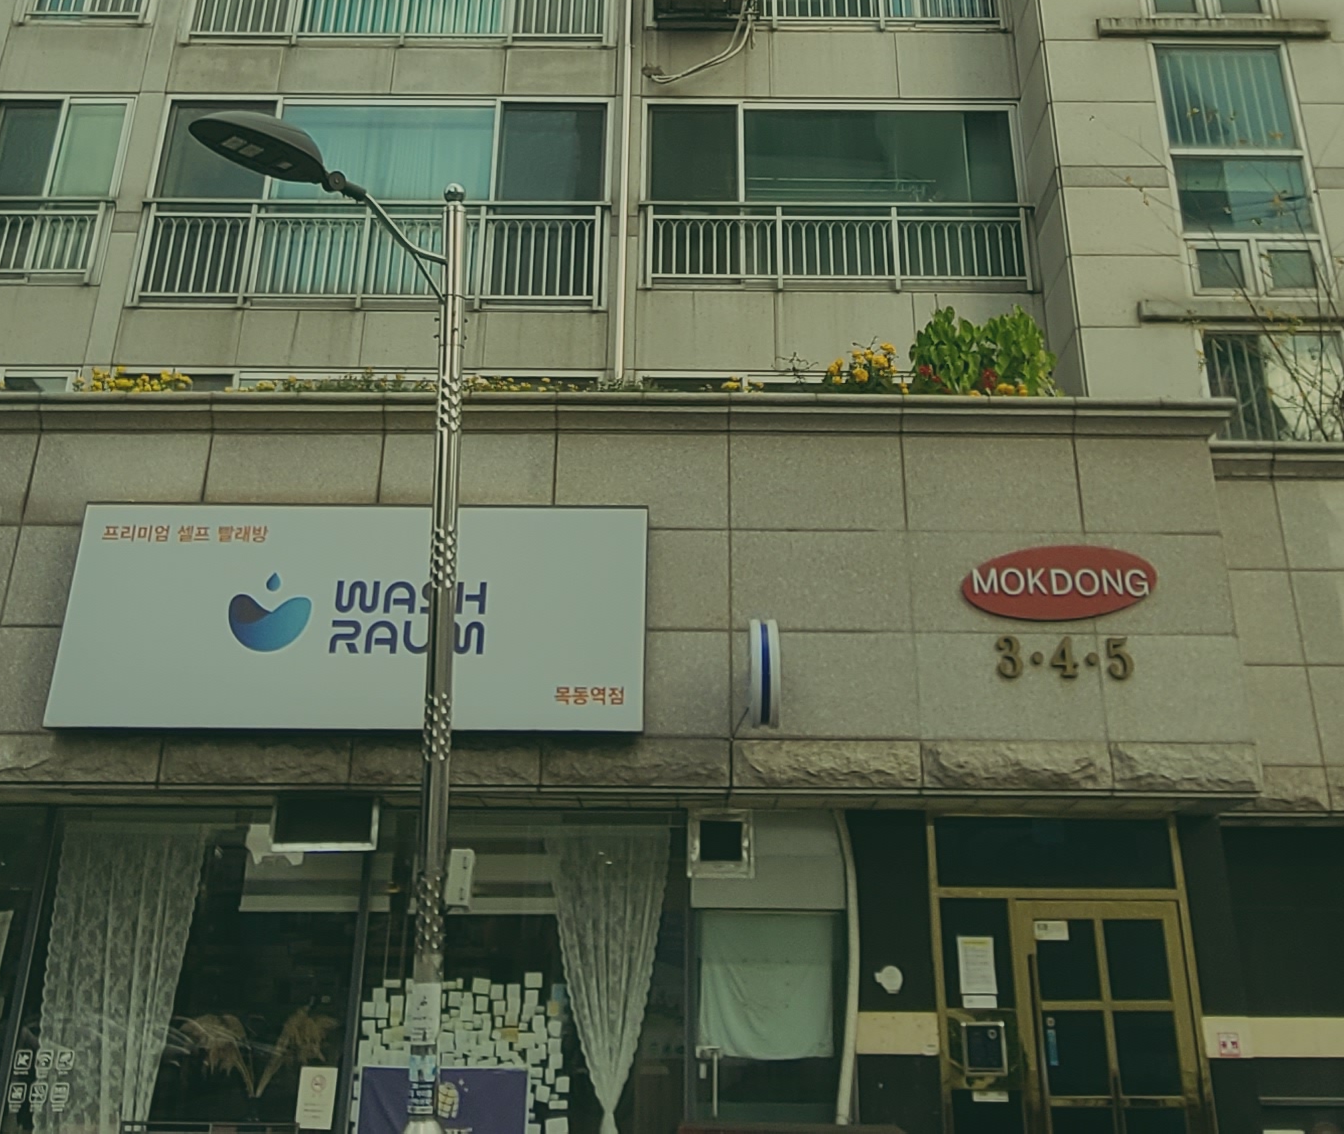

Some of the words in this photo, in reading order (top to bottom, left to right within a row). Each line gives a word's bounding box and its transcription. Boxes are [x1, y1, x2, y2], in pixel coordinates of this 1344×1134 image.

[102, 524, 171, 543] 프리미엄
[177, 524, 210, 543] 셀프
[218, 524, 269, 545] 빨래방
[972, 567, 1149, 598] MOKDONG
[554, 686, 625, 706] 목동역점
